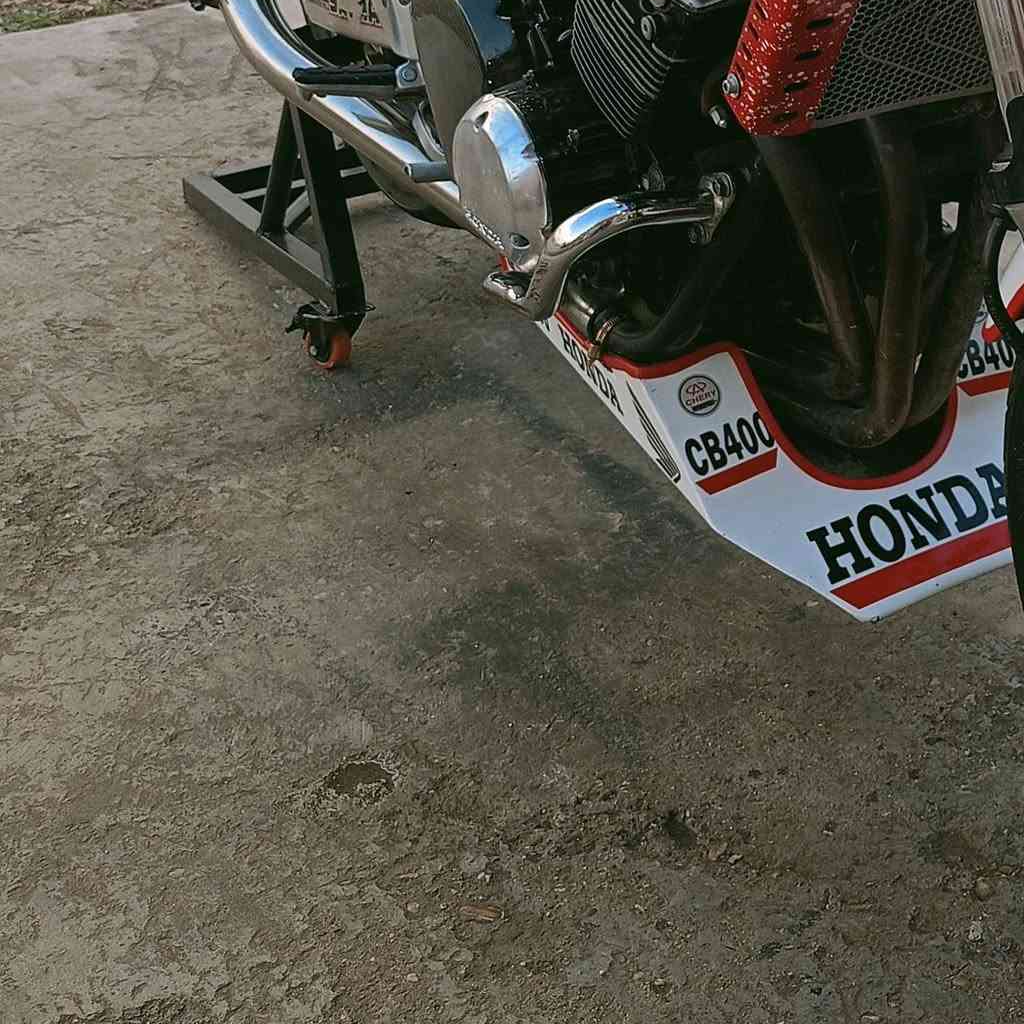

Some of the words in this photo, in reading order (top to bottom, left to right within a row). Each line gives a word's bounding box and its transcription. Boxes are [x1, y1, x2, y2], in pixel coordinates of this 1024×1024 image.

[685, 389, 717, 407] CHERY
[685, 411, 775, 476] CB400
[806, 462, 1009, 585] HONDA
